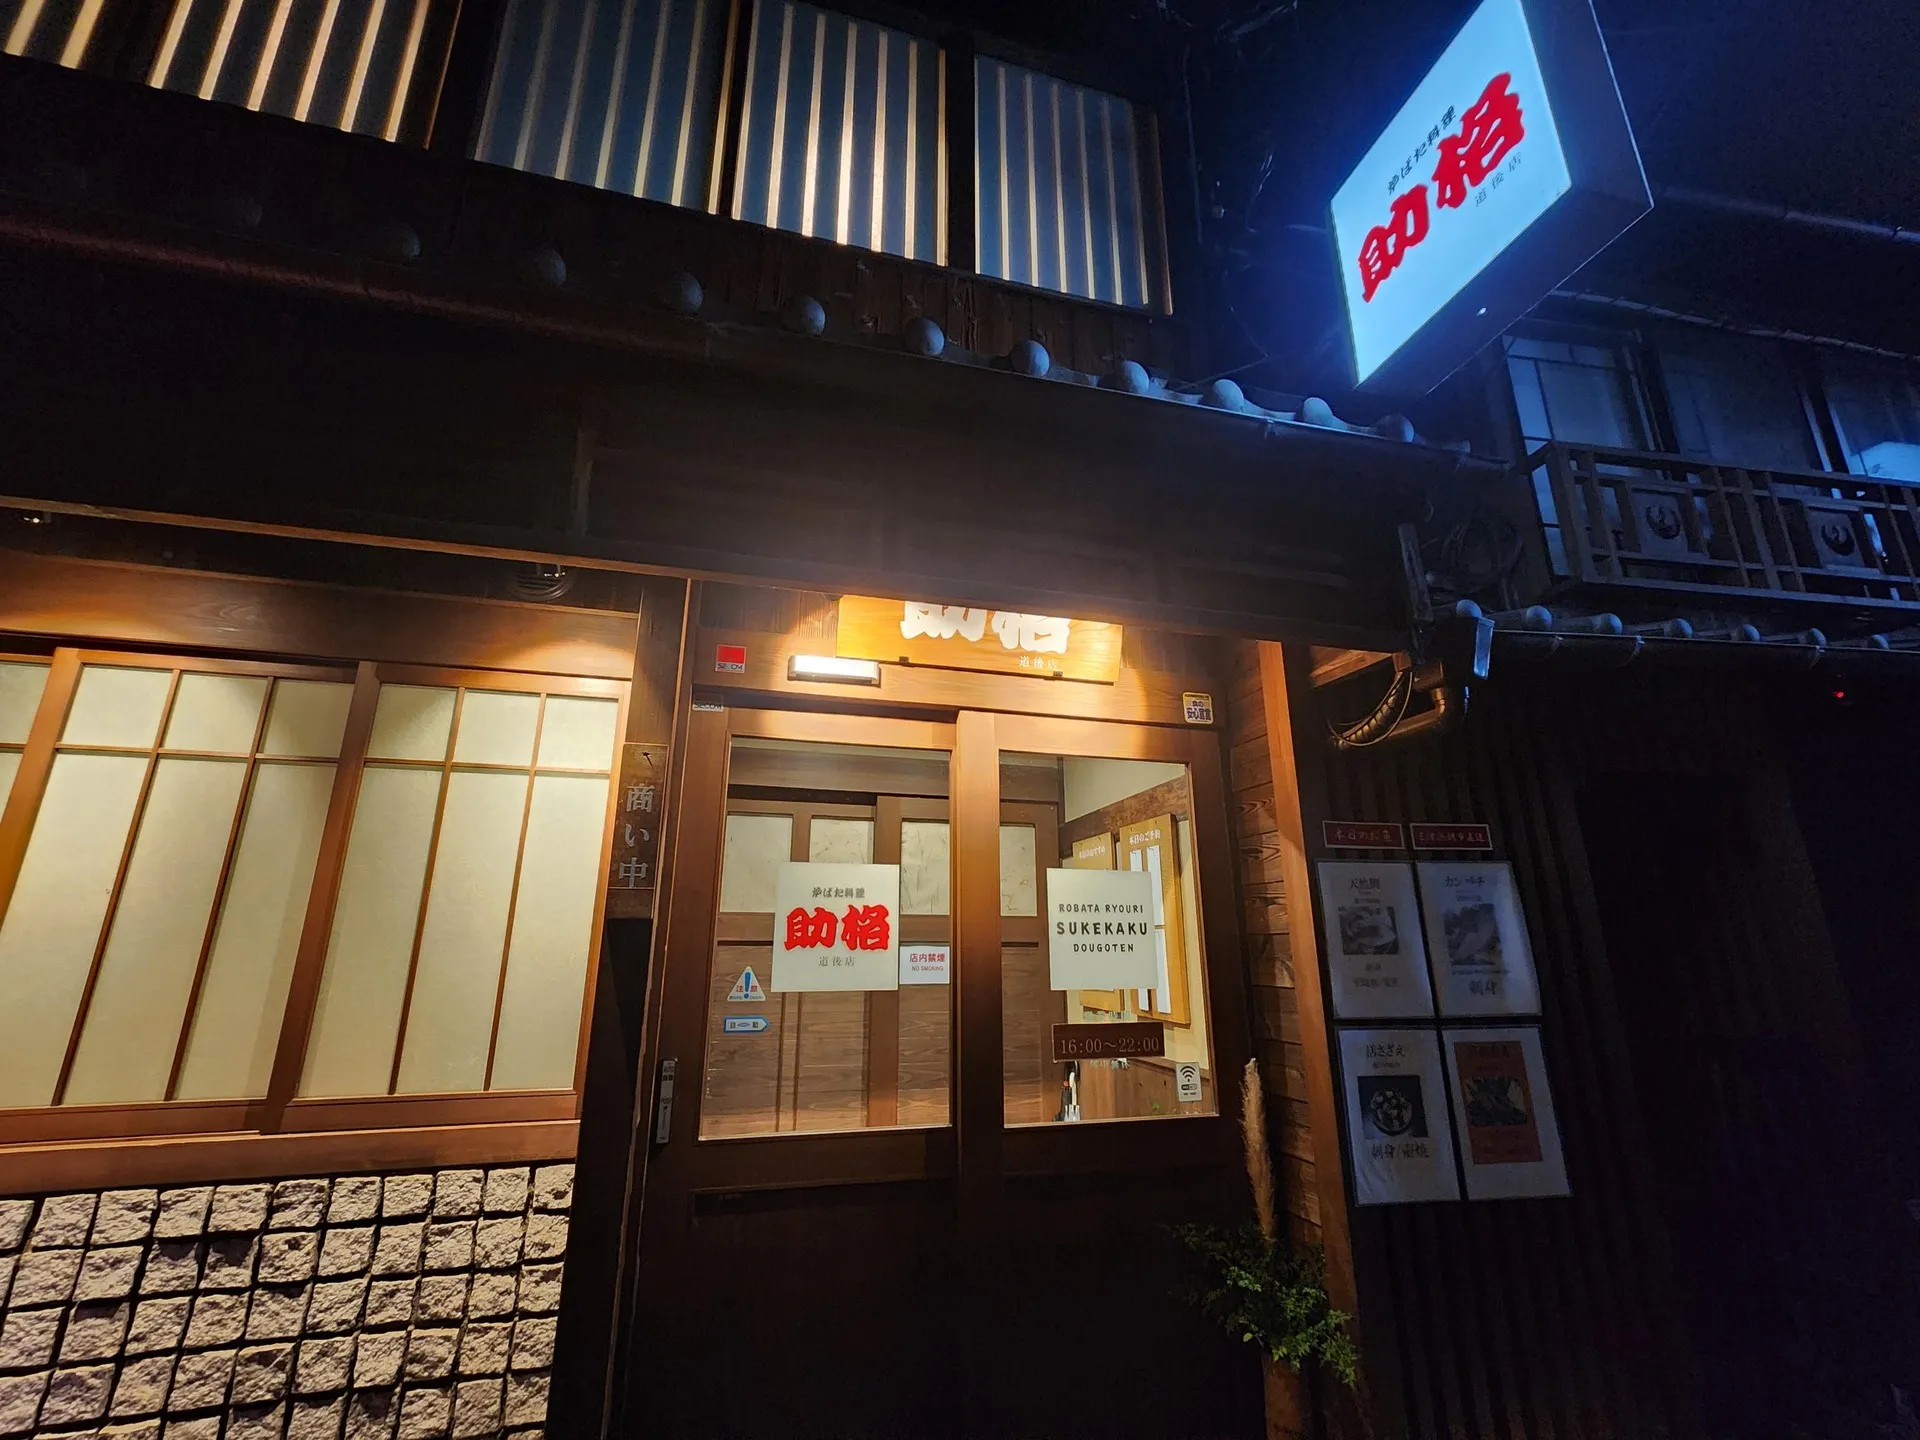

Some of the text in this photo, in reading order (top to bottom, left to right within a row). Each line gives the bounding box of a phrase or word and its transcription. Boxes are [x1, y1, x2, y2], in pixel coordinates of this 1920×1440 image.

[1474, 152, 1522, 207] 道後店
[1358, 72, 1525, 303] 助格
[618, 782, 656, 889] 商い中
[1058, 903, 1144, 914] ROBATA RYOURI
[783, 904, 891, 952] 助格
[1056, 921, 1149, 936] SUKEKAKU
[1073, 942, 1134, 953] DOUGOTEN
[818, 955, 857, 968] 道後店
[909, 952, 945, 963] 店内禁煙
